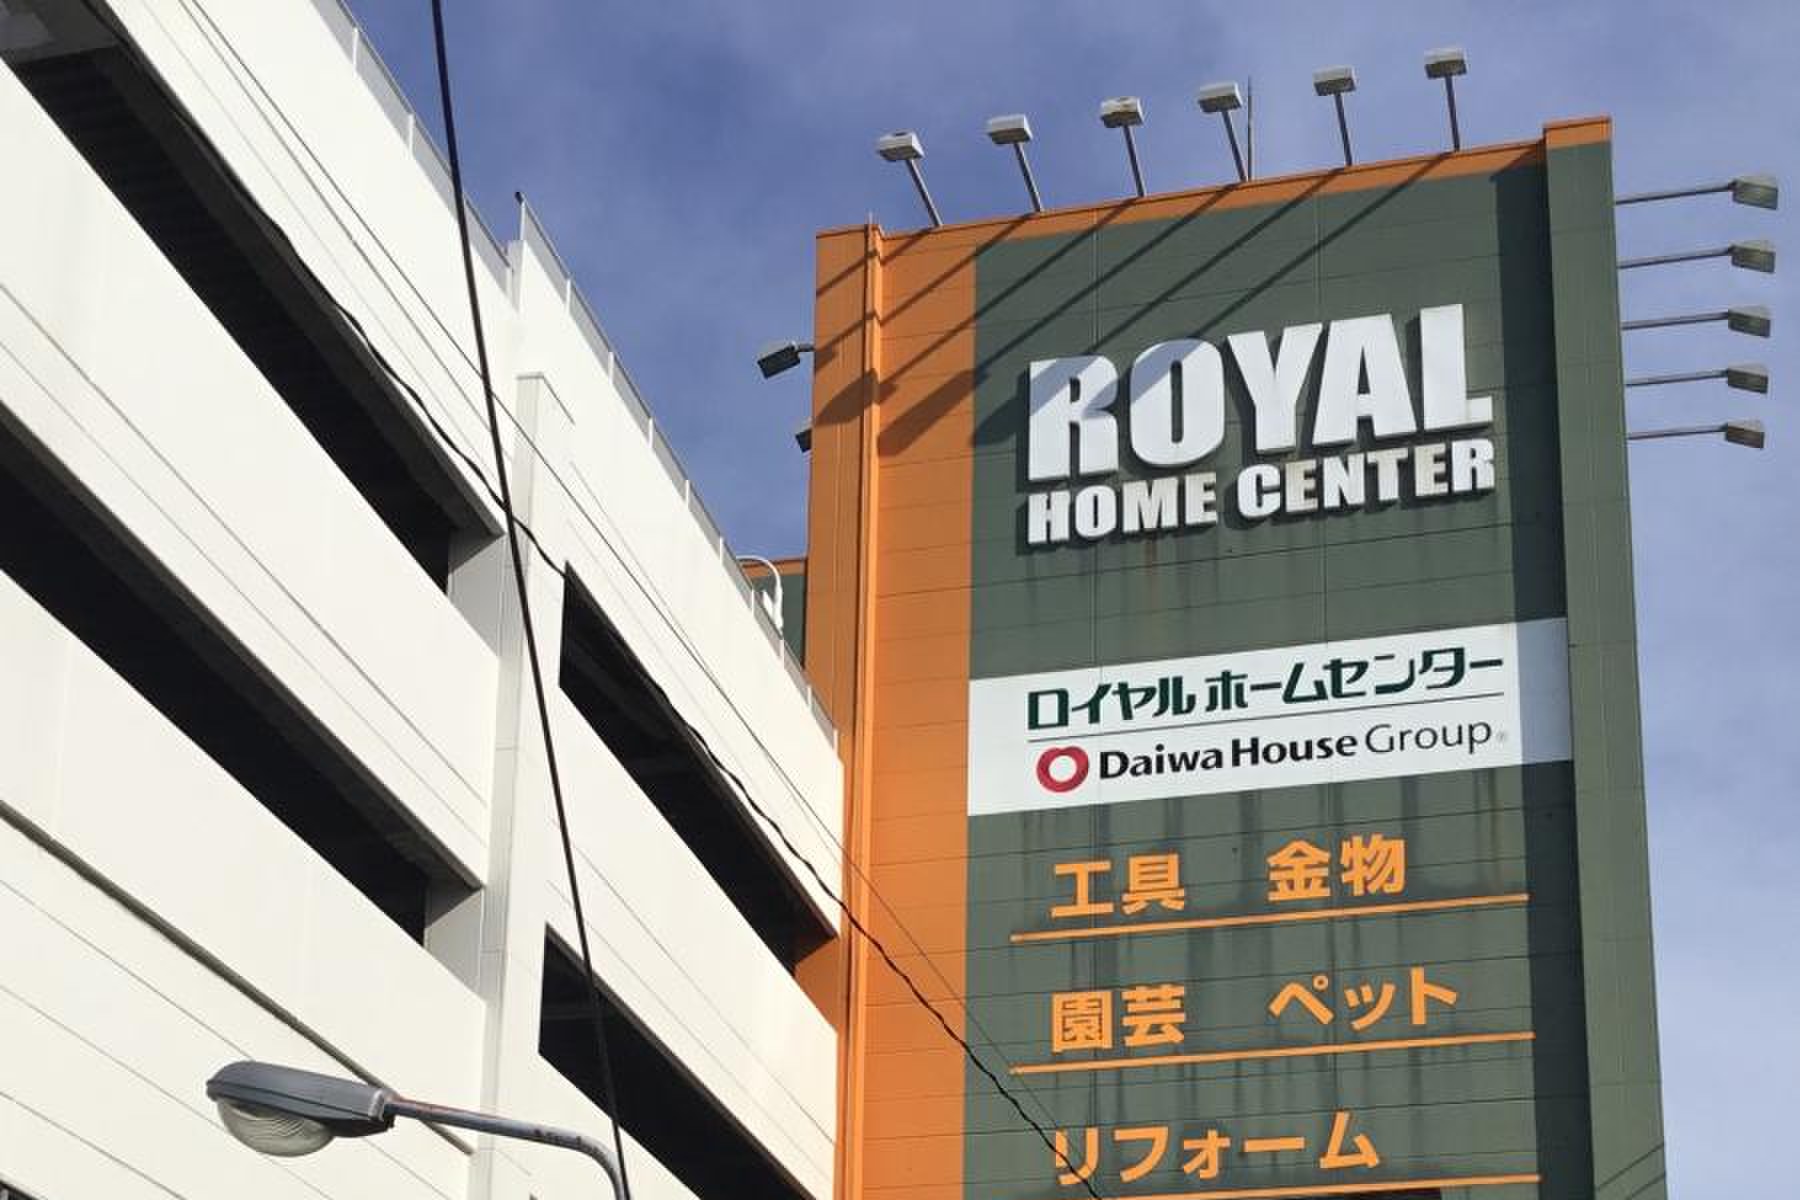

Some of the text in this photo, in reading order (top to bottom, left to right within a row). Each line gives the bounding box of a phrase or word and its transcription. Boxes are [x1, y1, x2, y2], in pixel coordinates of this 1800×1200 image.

[1027, 303, 1493, 482] ROYAL
[1027, 437, 1496, 545] HOME CENTER
[1027, 646, 1504, 731] ロイヤルホームセンター
[1100, 721, 1492, 779] Daiwa House Group
[1051, 834, 1406, 919] 工具 金物
[1051, 966, 1457, 1053] 園芸 ペット
[1054, 1111, 1381, 1186] リフォーム
